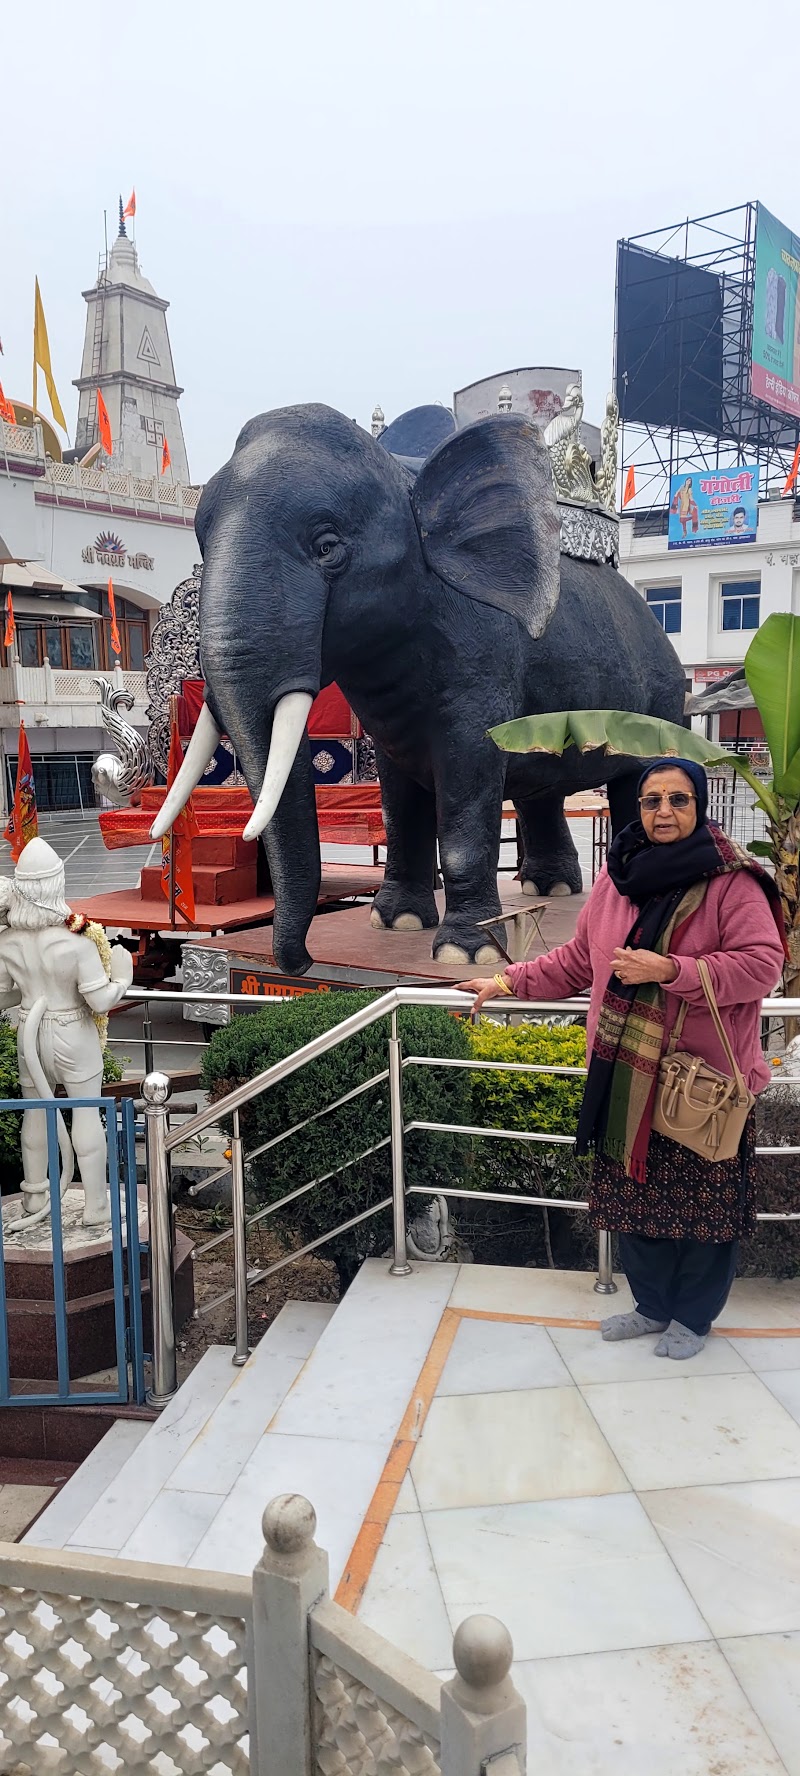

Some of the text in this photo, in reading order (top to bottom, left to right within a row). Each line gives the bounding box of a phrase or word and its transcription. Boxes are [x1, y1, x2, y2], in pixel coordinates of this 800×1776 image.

[700, 471, 753, 495] गंगोली
[82, 545, 95, 564] श्री
[96, 552, 125, 567] नवग्रह
[241, 975, 261, 996] श्री
